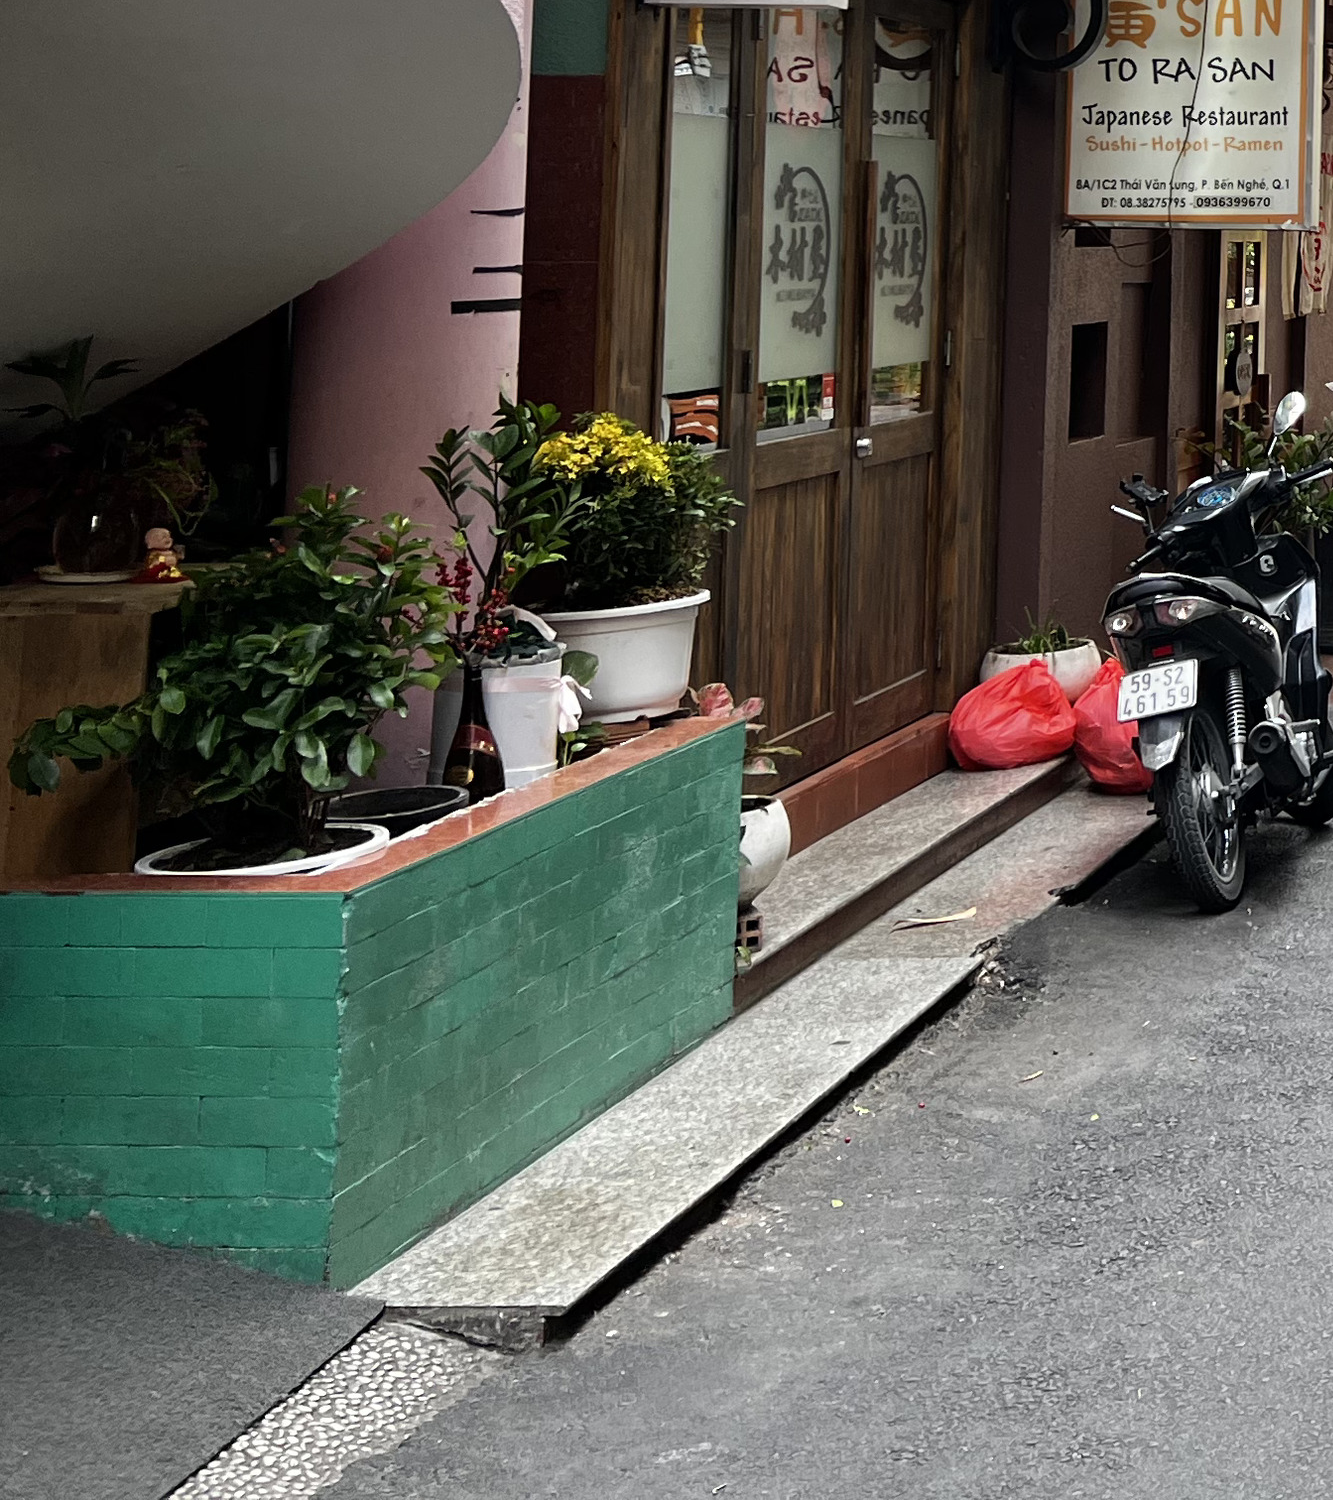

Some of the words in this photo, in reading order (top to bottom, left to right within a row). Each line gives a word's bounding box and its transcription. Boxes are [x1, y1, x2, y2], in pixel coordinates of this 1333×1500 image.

[1097, 58, 1138, 84] TO
[1152, 58, 1197, 84] RA
[1207, 57, 1275, 83] SAN
[1081, 102, 1173, 133] Japanese
[1182, 105, 1289, 128] Restaurant
[1075, 179, 1118, 191] 8A/1C2
[1119, 178, 1142, 190] Thái
[1144, 178, 1167, 190] Văn
[1201, 179, 1212, 190] P.
[1214, 177, 1234, 190] Bến
[1236, 178, 1270, 192] Nghé,
[1272, 178, 1290, 190] Q.1
[1119, 197, 1186, 208] 08.38275795
[1195, 197, 1272, 208] 0936399670
[1130, 666, 1184, 694] 59-S2
[1123, 685, 1190, 717] 461.59
